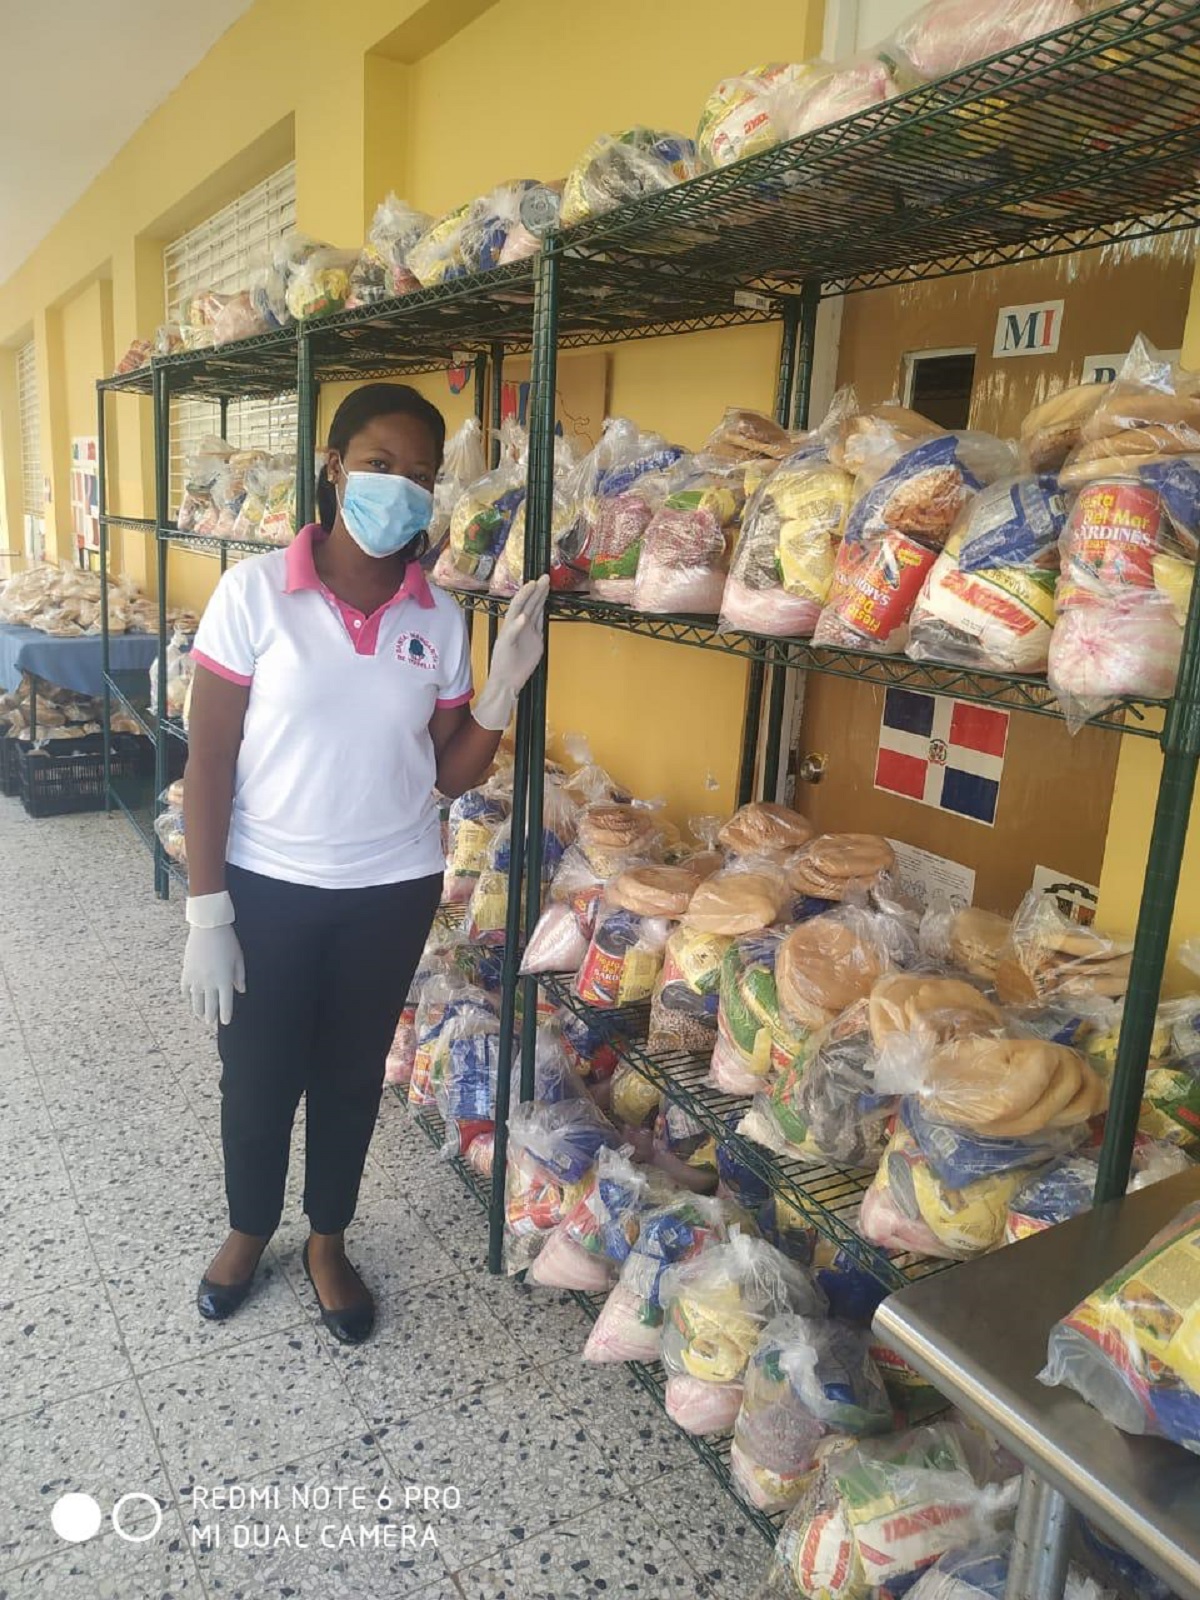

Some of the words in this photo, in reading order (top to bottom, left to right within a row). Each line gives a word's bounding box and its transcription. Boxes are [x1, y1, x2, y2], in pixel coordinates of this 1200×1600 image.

[1002, 309, 1056, 350] MI
[1113, 510, 1150, 530] Mar
[1073, 524, 1151, 546] SARDINES
